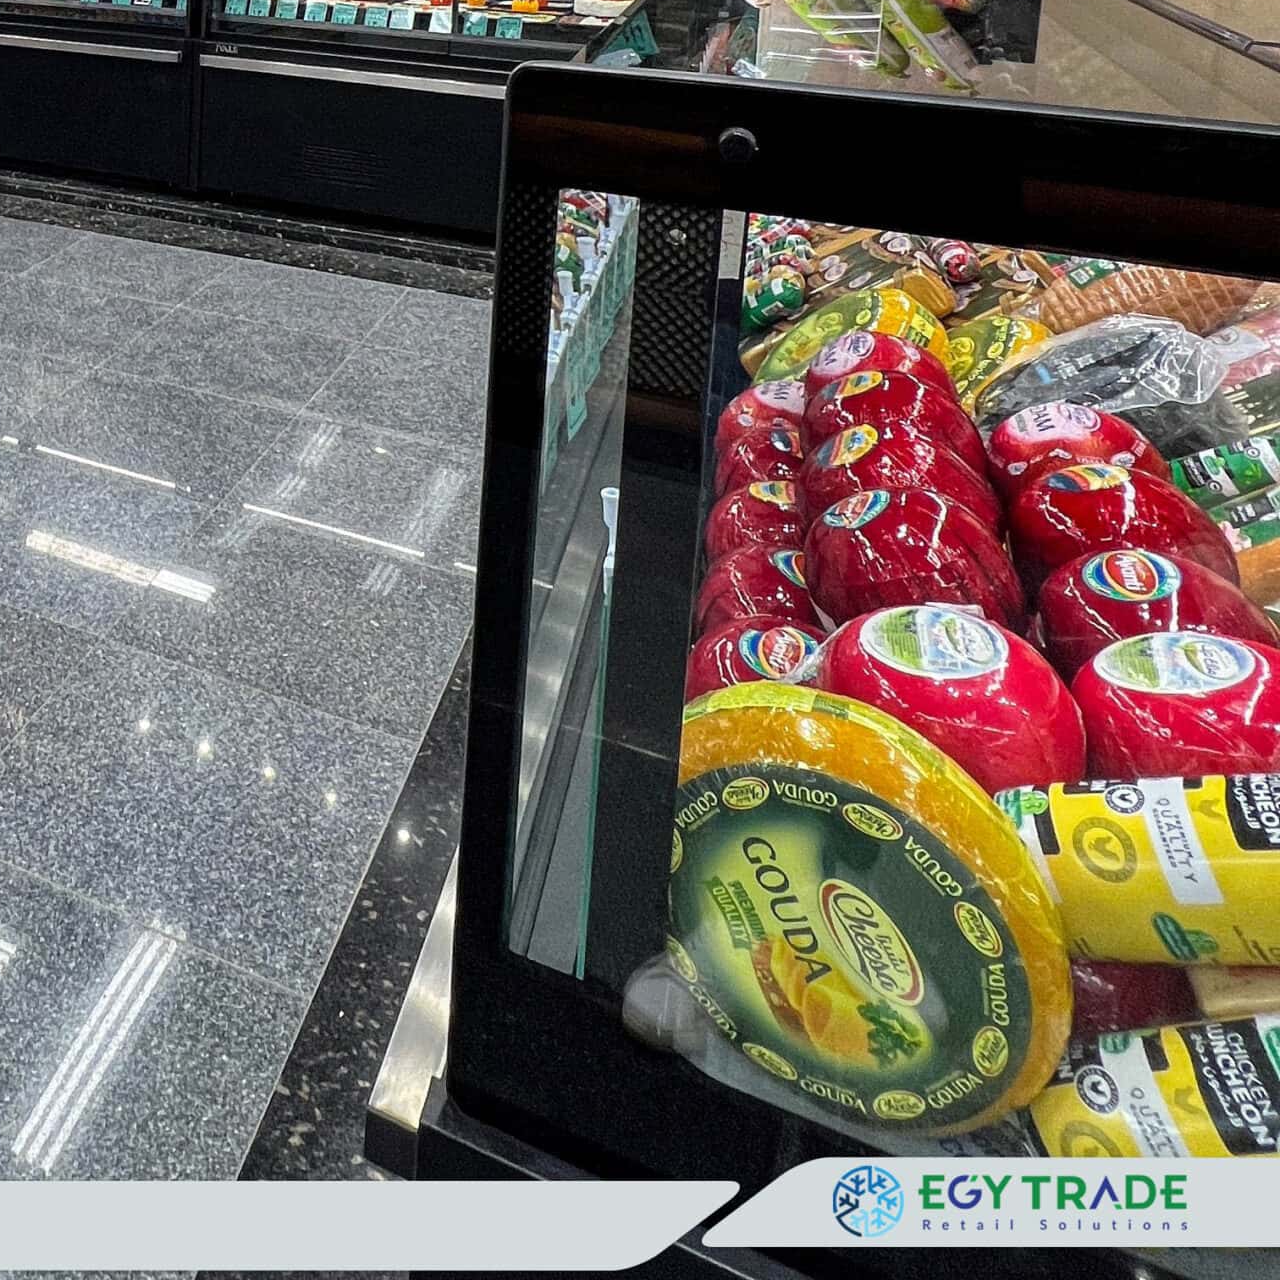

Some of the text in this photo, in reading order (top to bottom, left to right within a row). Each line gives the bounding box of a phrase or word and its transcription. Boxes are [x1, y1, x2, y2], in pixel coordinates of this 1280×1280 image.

[675, 791, 718, 828] GOUDA
[772, 779, 838, 808] GOUDA
[904, 835, 964, 897] GOUDA
[1154, 797, 1199, 884] QUALITY
[712, 886, 750, 948] QUALITY
[742, 836, 832, 984] GOUDA
[689, 984, 739, 1040] GOUDA
[987, 963, 1010, 1026] GOUDA
[799, 1078, 868, 1115] GOUDA
[927, 1072, 984, 1109] GOUDA
[1206, 1022, 1277, 1147] LUNCHEON
[1226, 1031, 1279, 1119] CHICKEN
